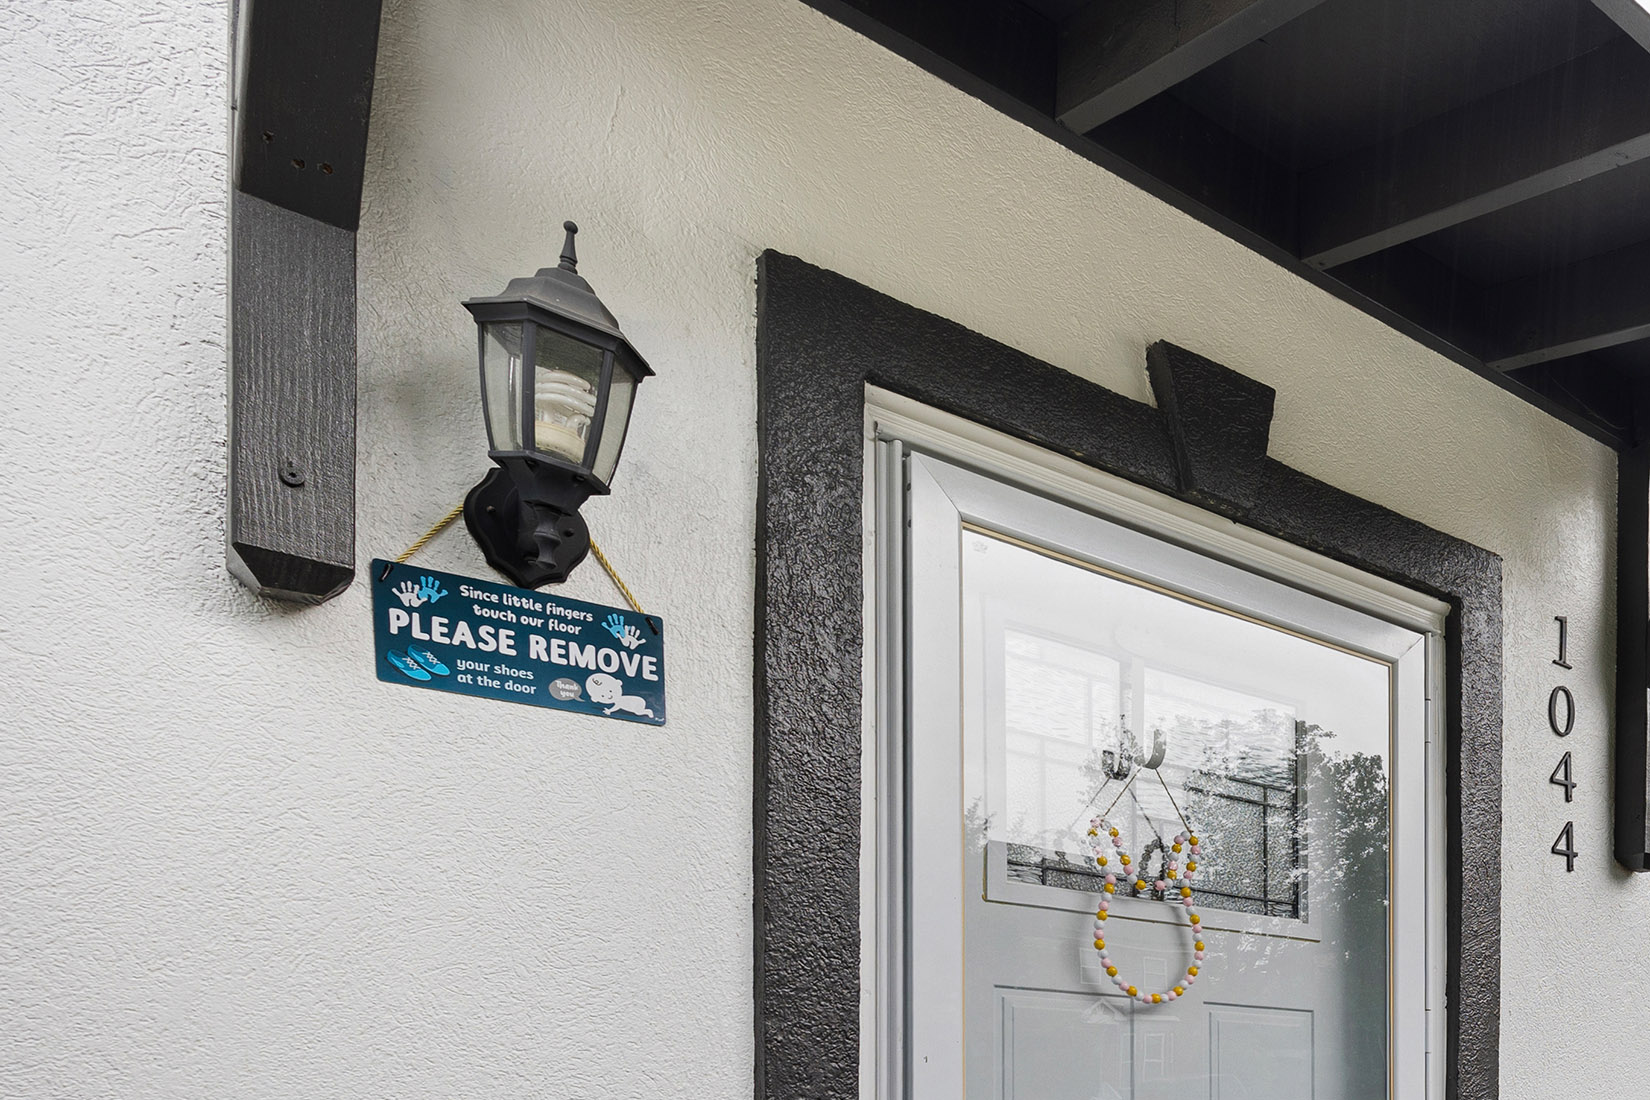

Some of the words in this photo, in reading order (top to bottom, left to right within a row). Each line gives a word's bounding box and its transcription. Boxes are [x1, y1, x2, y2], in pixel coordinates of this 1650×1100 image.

[460, 585, 499, 603] Since
[503, 593, 542, 611] little
[547, 603, 593, 621] fingers
[473, 604, 516, 623] touch
[520, 616, 544, 627] our
[549, 619, 581, 634] floor
[389, 608, 517, 656] PLEASE
[529, 635, 658, 681] REMOVE
[457, 660, 490, 672] your
[494, 664, 534, 679] shoes
[458, 674, 473, 684] at
[477, 676, 500, 688] the
[505, 681, 536, 694] door
[555, 680, 578, 691] Thank
[560, 690, 575, 698] you
[1548, 616, 1579, 873] 1044
